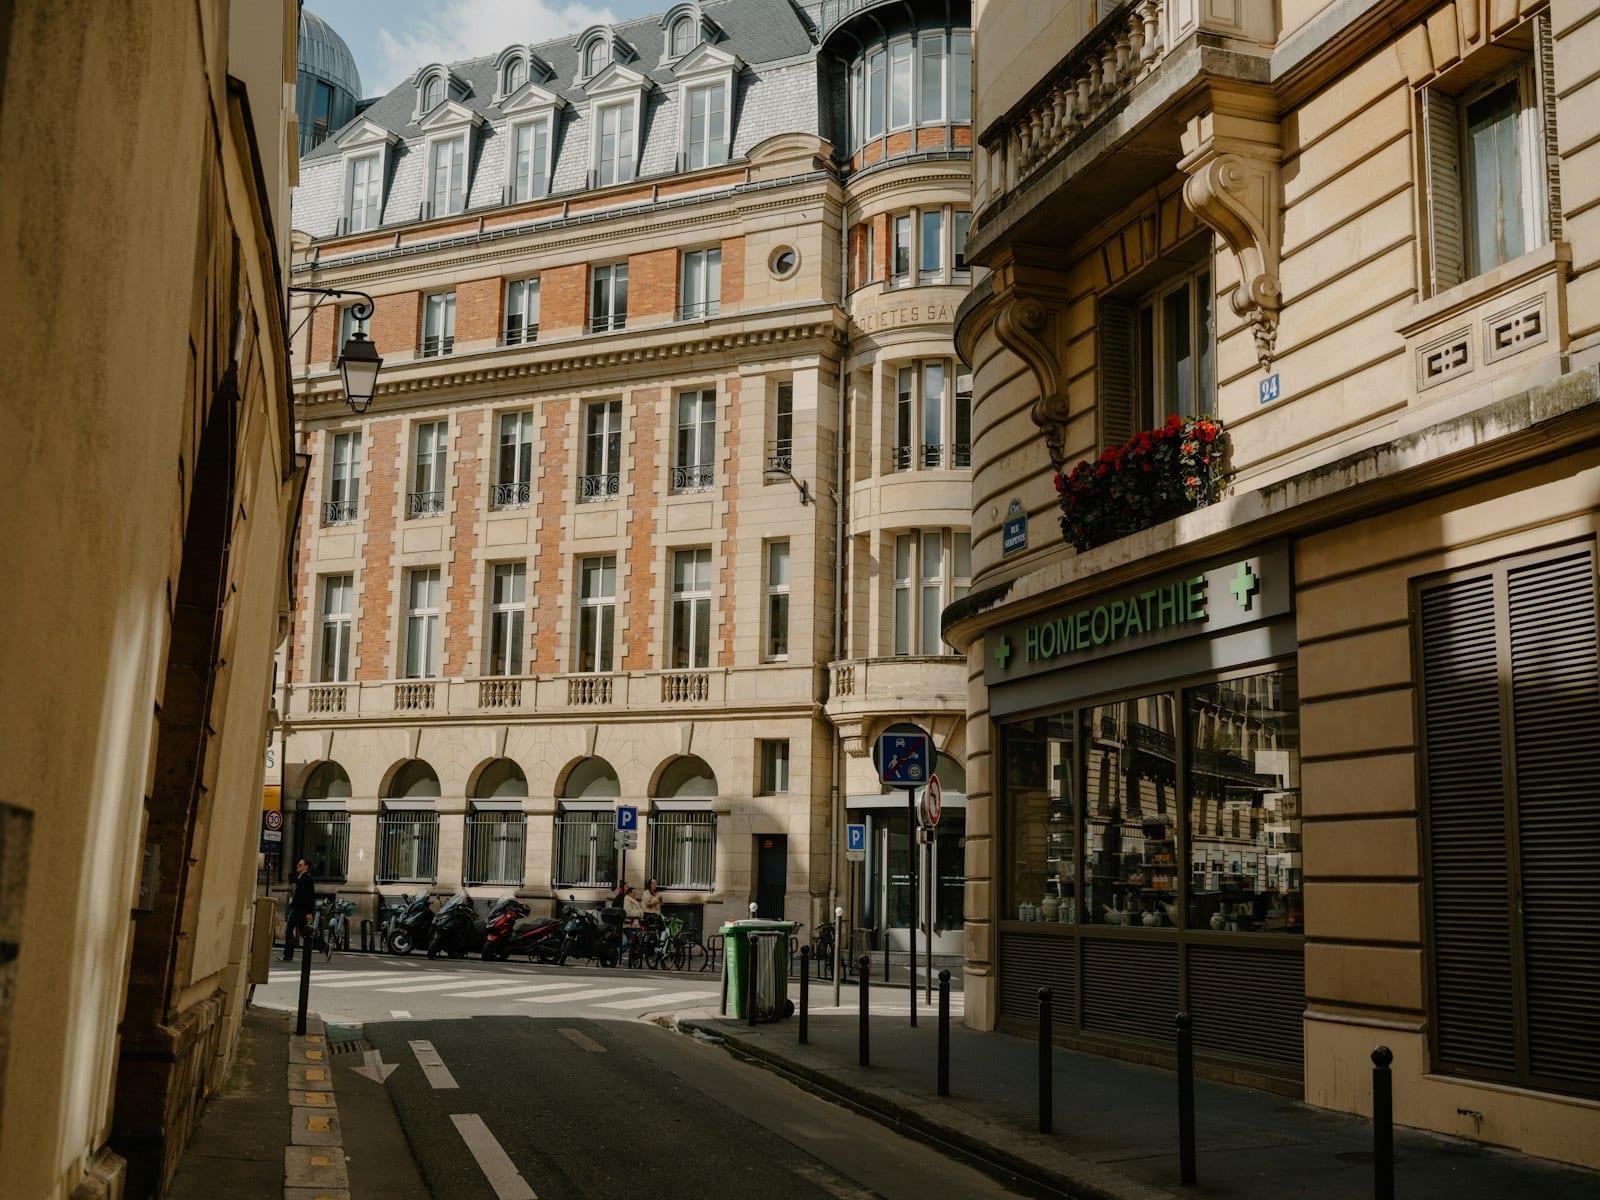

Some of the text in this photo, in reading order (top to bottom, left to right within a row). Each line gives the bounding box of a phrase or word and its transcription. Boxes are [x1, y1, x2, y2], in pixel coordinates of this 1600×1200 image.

[1261, 376, 1278, 402] 24
[1024, 575, 1207, 662] HOMEOPATHIE
[269, 815, 279, 824] 30
[622, 810, 632, 827] P
[852, 829, 861, 846] P
